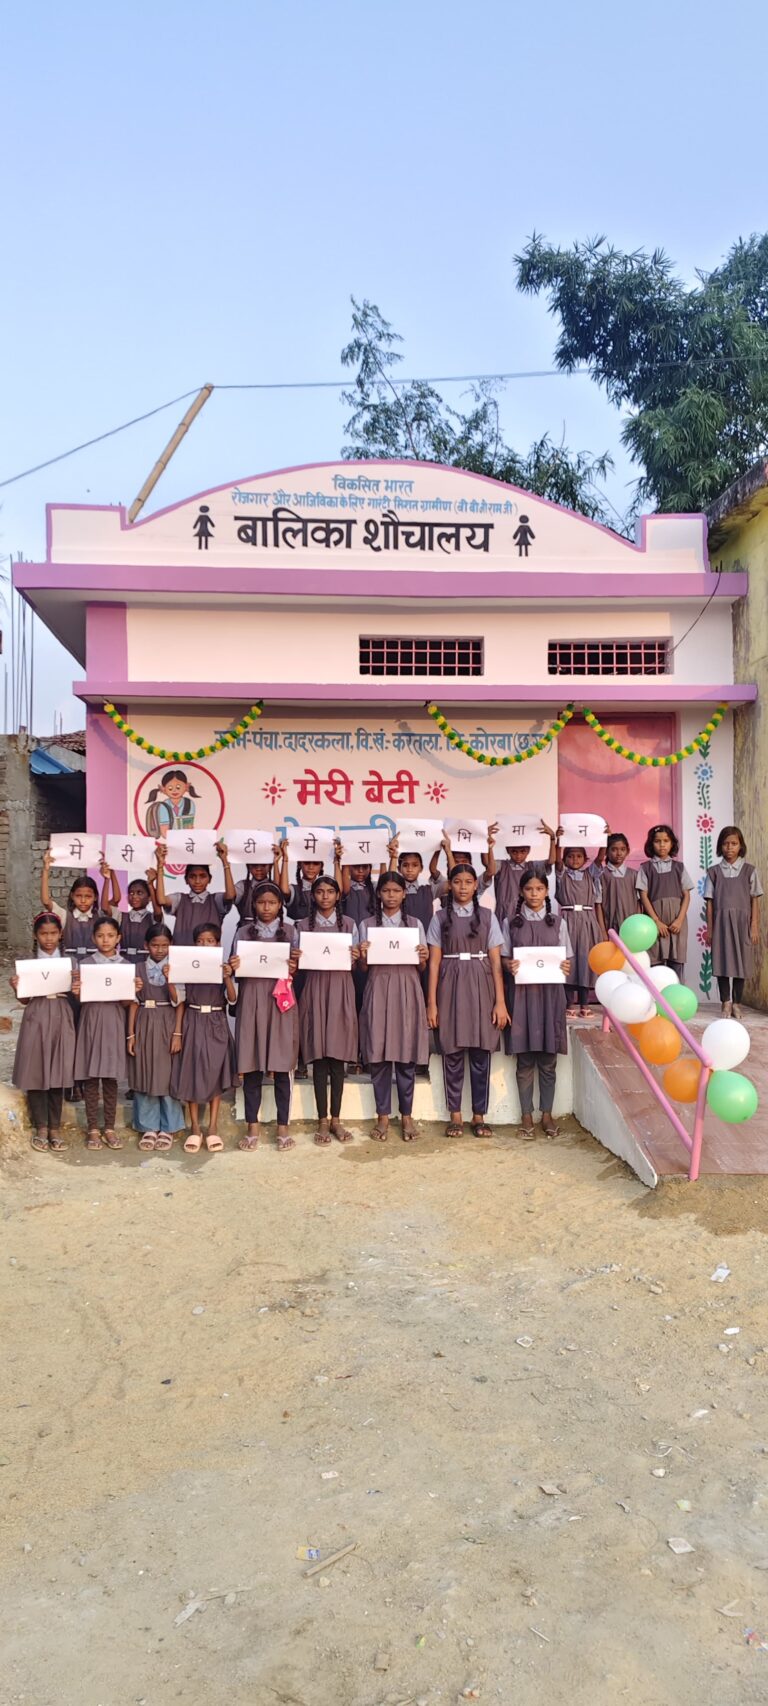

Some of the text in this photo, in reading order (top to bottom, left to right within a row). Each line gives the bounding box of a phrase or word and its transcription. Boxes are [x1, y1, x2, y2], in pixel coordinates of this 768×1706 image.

[332, 474, 414, 497] विकसित भारत
[231, 487, 271, 508] रोजगार
[272, 488, 291, 507] और
[234, 507, 494, 554] बालिका शौचालय
[293, 769, 419, 806] मेरी बेटी
[456, 827, 473, 843] भि
[511, 824, 527, 837] मा
[577, 825, 590, 838] न
[68, 838, 84, 861] मे
[184, 837, 196, 855] बे
[243, 838, 257, 854] टी
[303, 832, 319, 855] मे
[357, 840, 371, 854] रा
[121, 844, 135, 863] री
[322, 945, 331, 955] A
[388, 940, 400, 950] M
[191, 959, 201, 969] G
[259, 954, 268, 964] R
[535, 959, 545, 969] G
[41, 971, 50, 981] V
[104, 977, 113, 987] B
